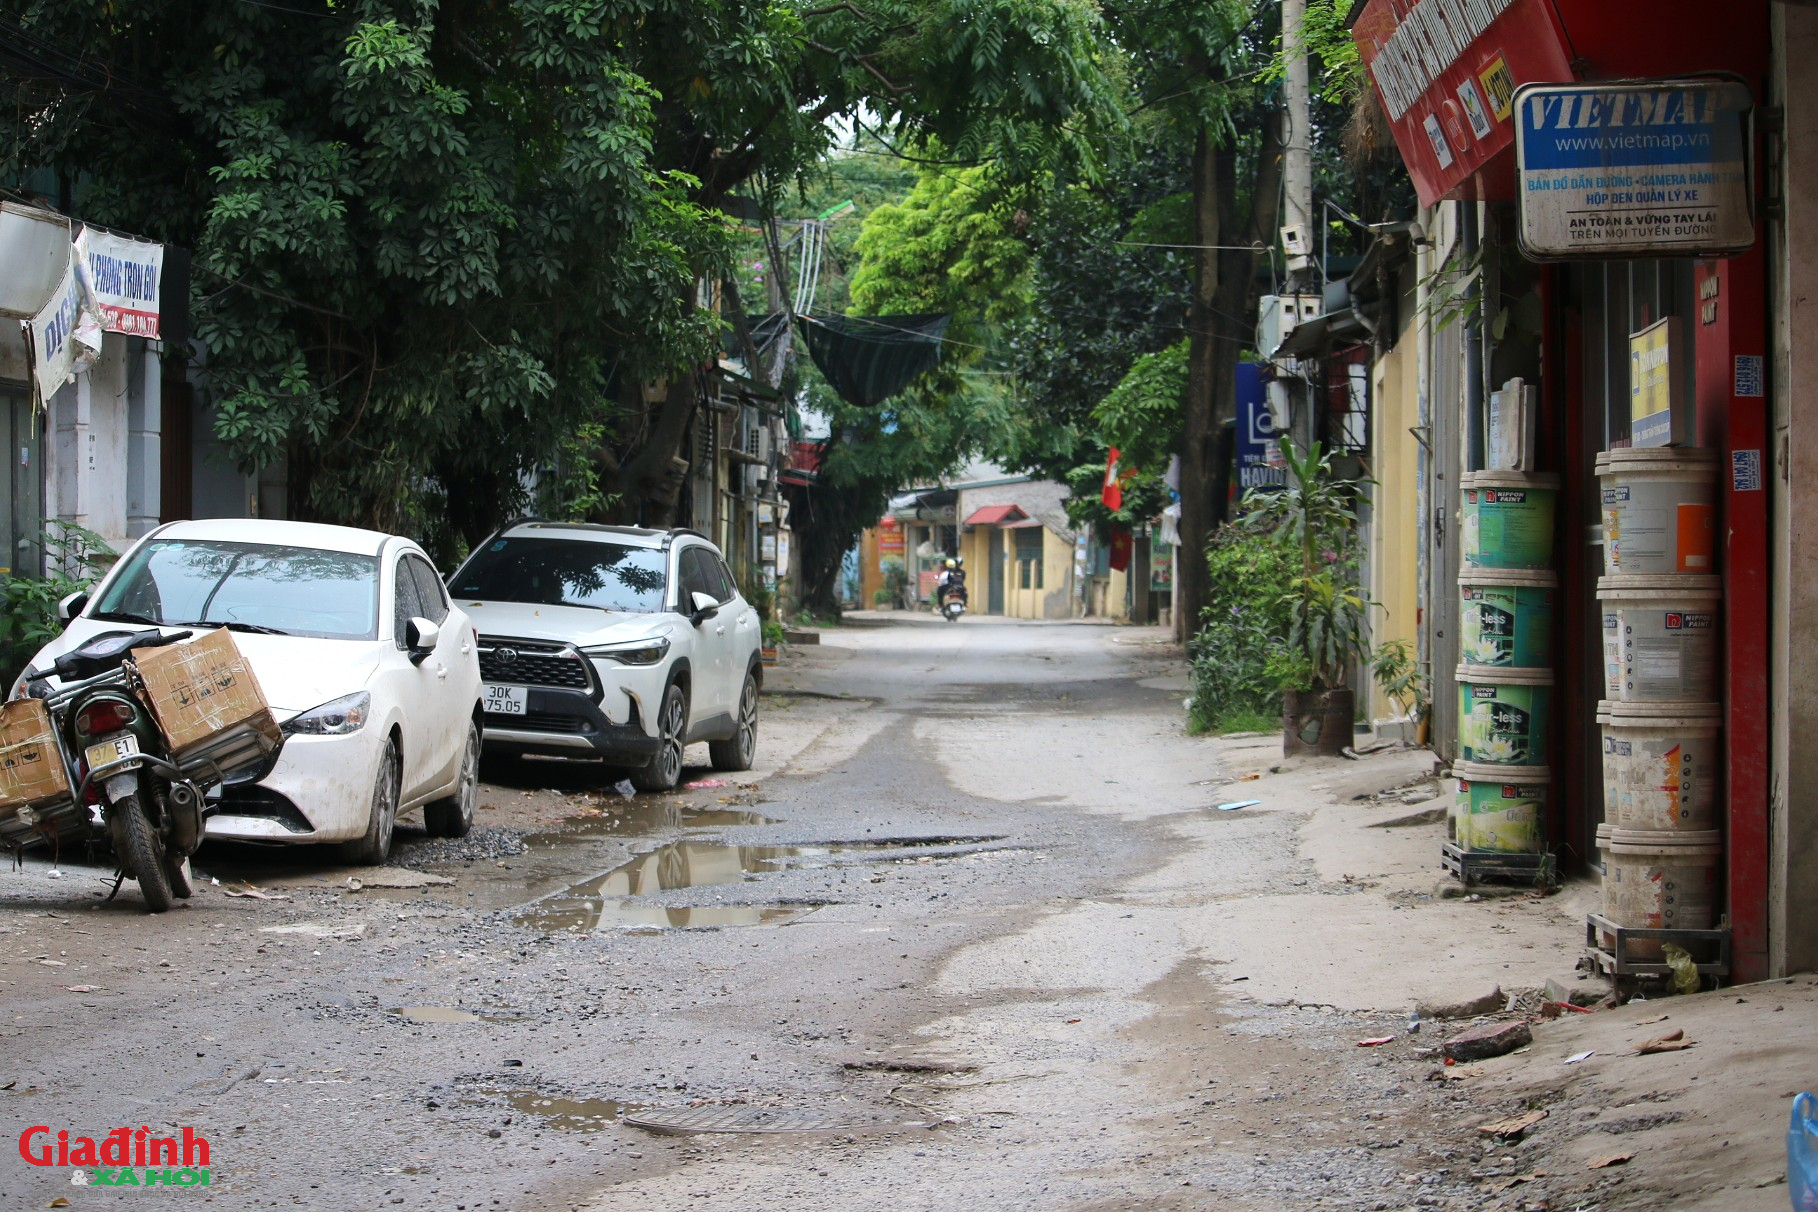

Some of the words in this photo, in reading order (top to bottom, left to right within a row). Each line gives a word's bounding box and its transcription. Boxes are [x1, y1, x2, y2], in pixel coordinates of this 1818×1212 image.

[1555, 132, 1710, 152] www.vietmap.vn
[1528, 176, 1550, 191] BẢN
[1553, 176, 1568, 190] ĐỒ
[1571, 175, 1593, 189] DẪN
[1597, 175, 1633, 188] ĐƯỜNG
[1641, 174, 1687, 187] CAMERA
[1586, 191, 1608, 206] HỘP
[1611, 192, 1633, 204] ĐEN
[1636, 189, 1664, 203] QUẢN
[1668, 188, 1682, 202] LÝ
[1684, 190, 1698, 201] XE
[1570, 218, 1586, 228] AN
[1589, 216, 1621, 227] TOÀN
[1625, 216, 1633, 226] &
[1636, 213, 1671, 225] VỮNG
[1673, 214, 1695, 223] TAY
[1698, 211, 1717, 222] LÁI
[1570, 229, 1600, 239] TRÊN
[1605, 228, 1628, 241] MỌI
[1632, 225, 1670, 238] TUYẾN
[489, 686, 512, 699] 30K
[484, 699, 521, 712] 75.05
[114, 739, 130, 755] E1
